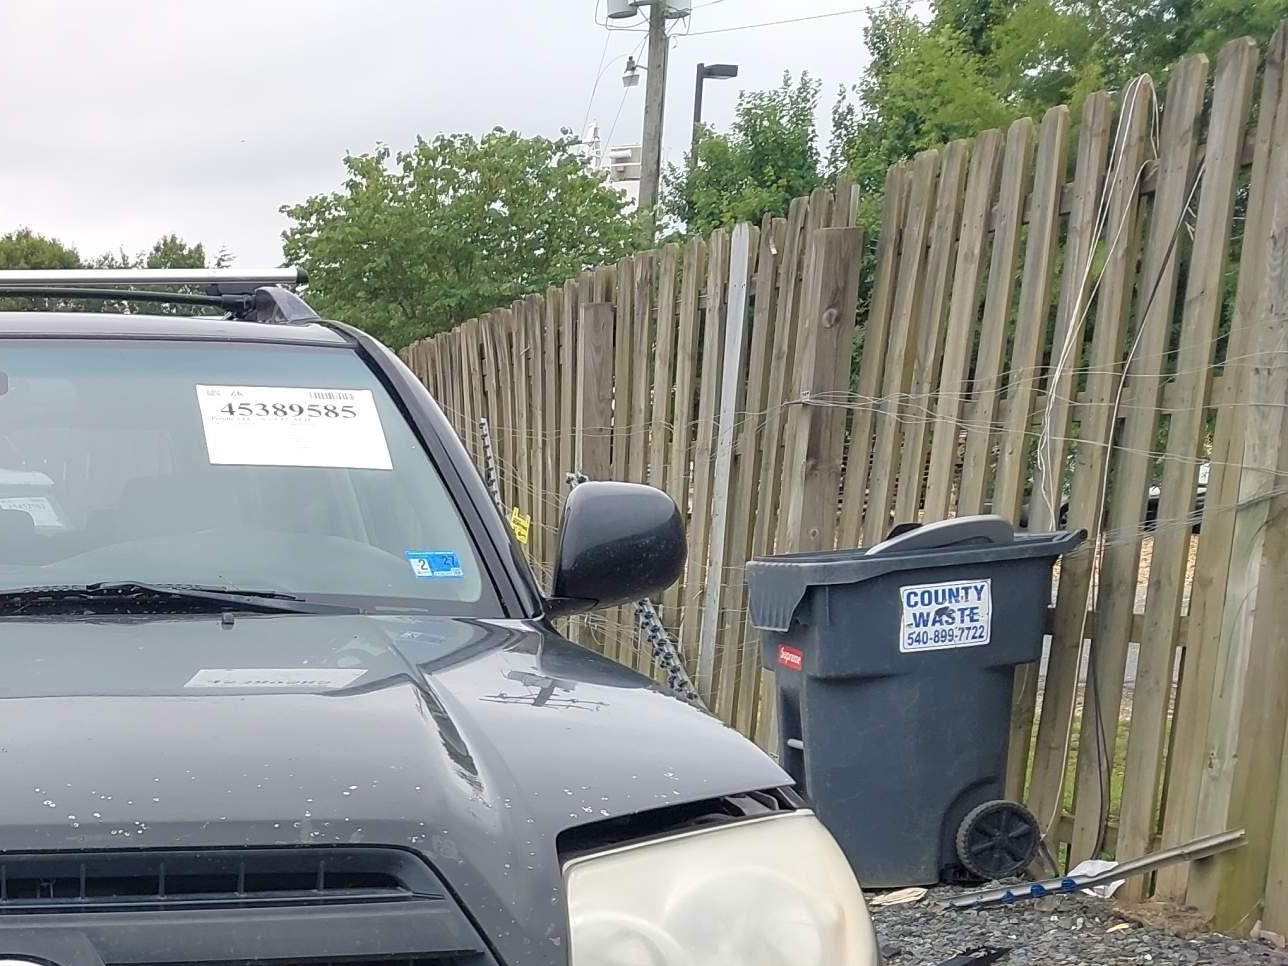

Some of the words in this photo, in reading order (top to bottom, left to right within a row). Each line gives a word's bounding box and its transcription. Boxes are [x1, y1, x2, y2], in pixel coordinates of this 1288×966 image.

[220, 402, 357, 419] 45389585
[906, 584, 985, 608] COUNTY
[912, 606, 980, 628] WASTE
[907, 625, 985, 646] 540-899-7722
